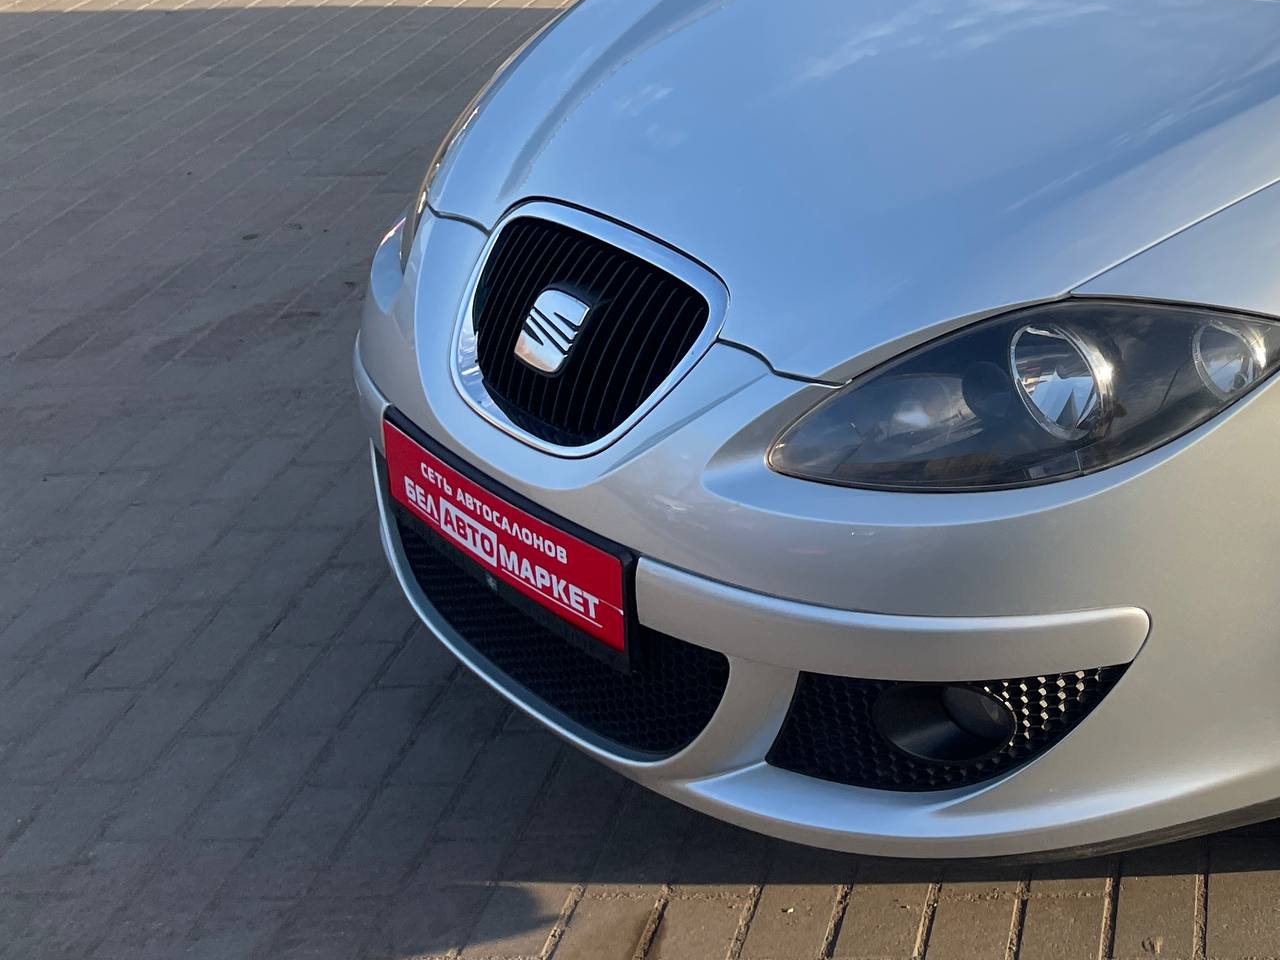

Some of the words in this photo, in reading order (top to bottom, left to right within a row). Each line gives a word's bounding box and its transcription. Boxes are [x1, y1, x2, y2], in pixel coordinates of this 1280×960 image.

[404, 476, 438, 519] БЕЛ
[443, 508, 495, 555] АВТО
[499, 543, 600, 620] МАРКЕТ
[420, 462, 452, 496] СЕТЬ
[456, 487, 568, 565] АВТОСАЛОНОВ
